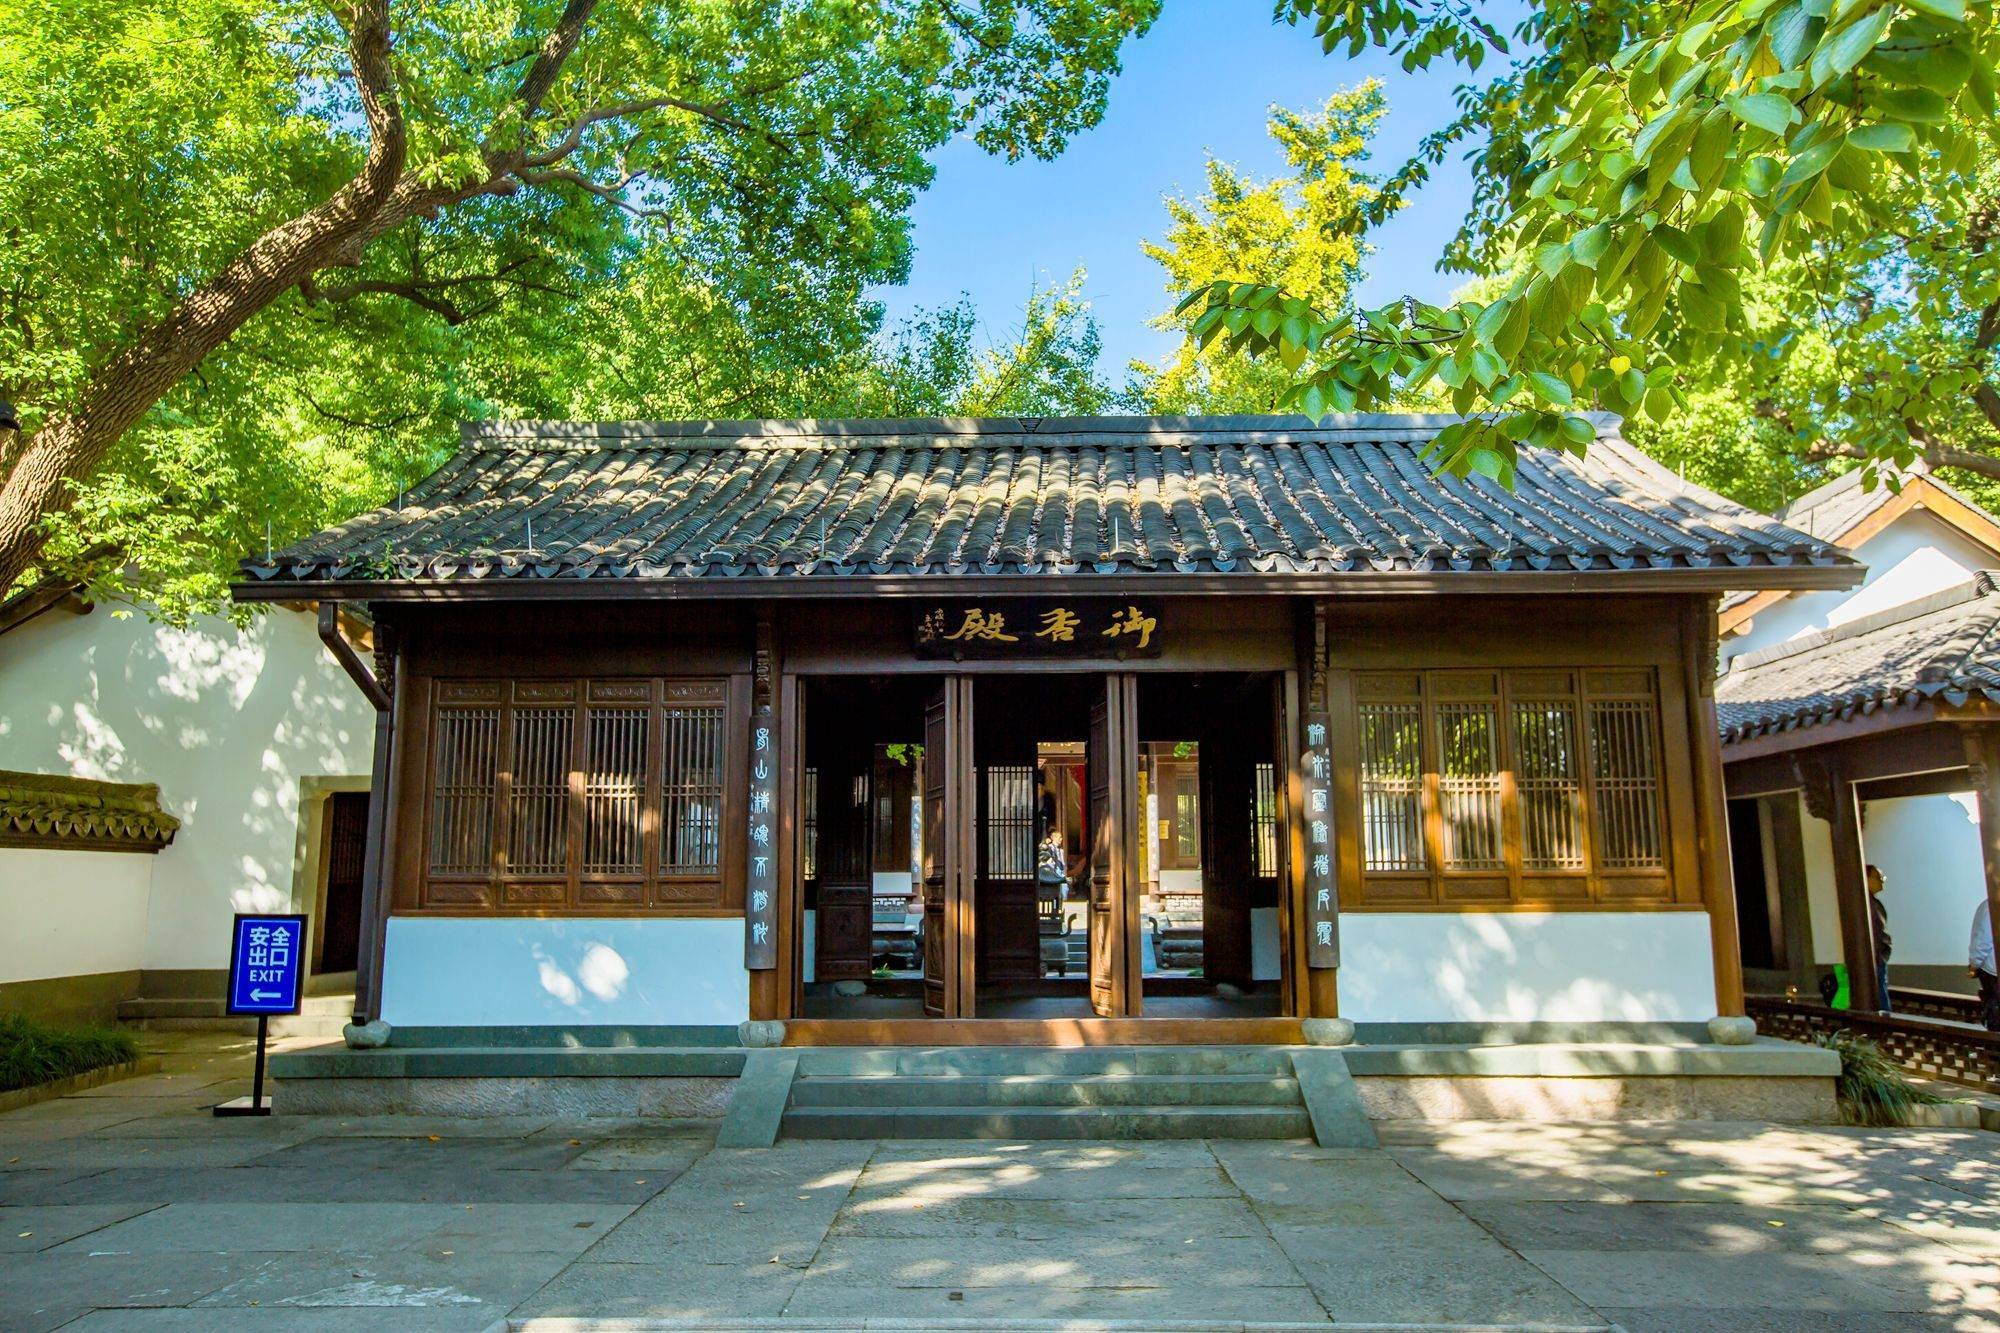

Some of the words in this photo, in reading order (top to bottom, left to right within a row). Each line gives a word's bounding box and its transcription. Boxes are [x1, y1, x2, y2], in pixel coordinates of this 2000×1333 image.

[249, 926, 291, 946] 安全
[248, 946, 288, 966] 出口
[249, 969, 284, 982] EXIT
